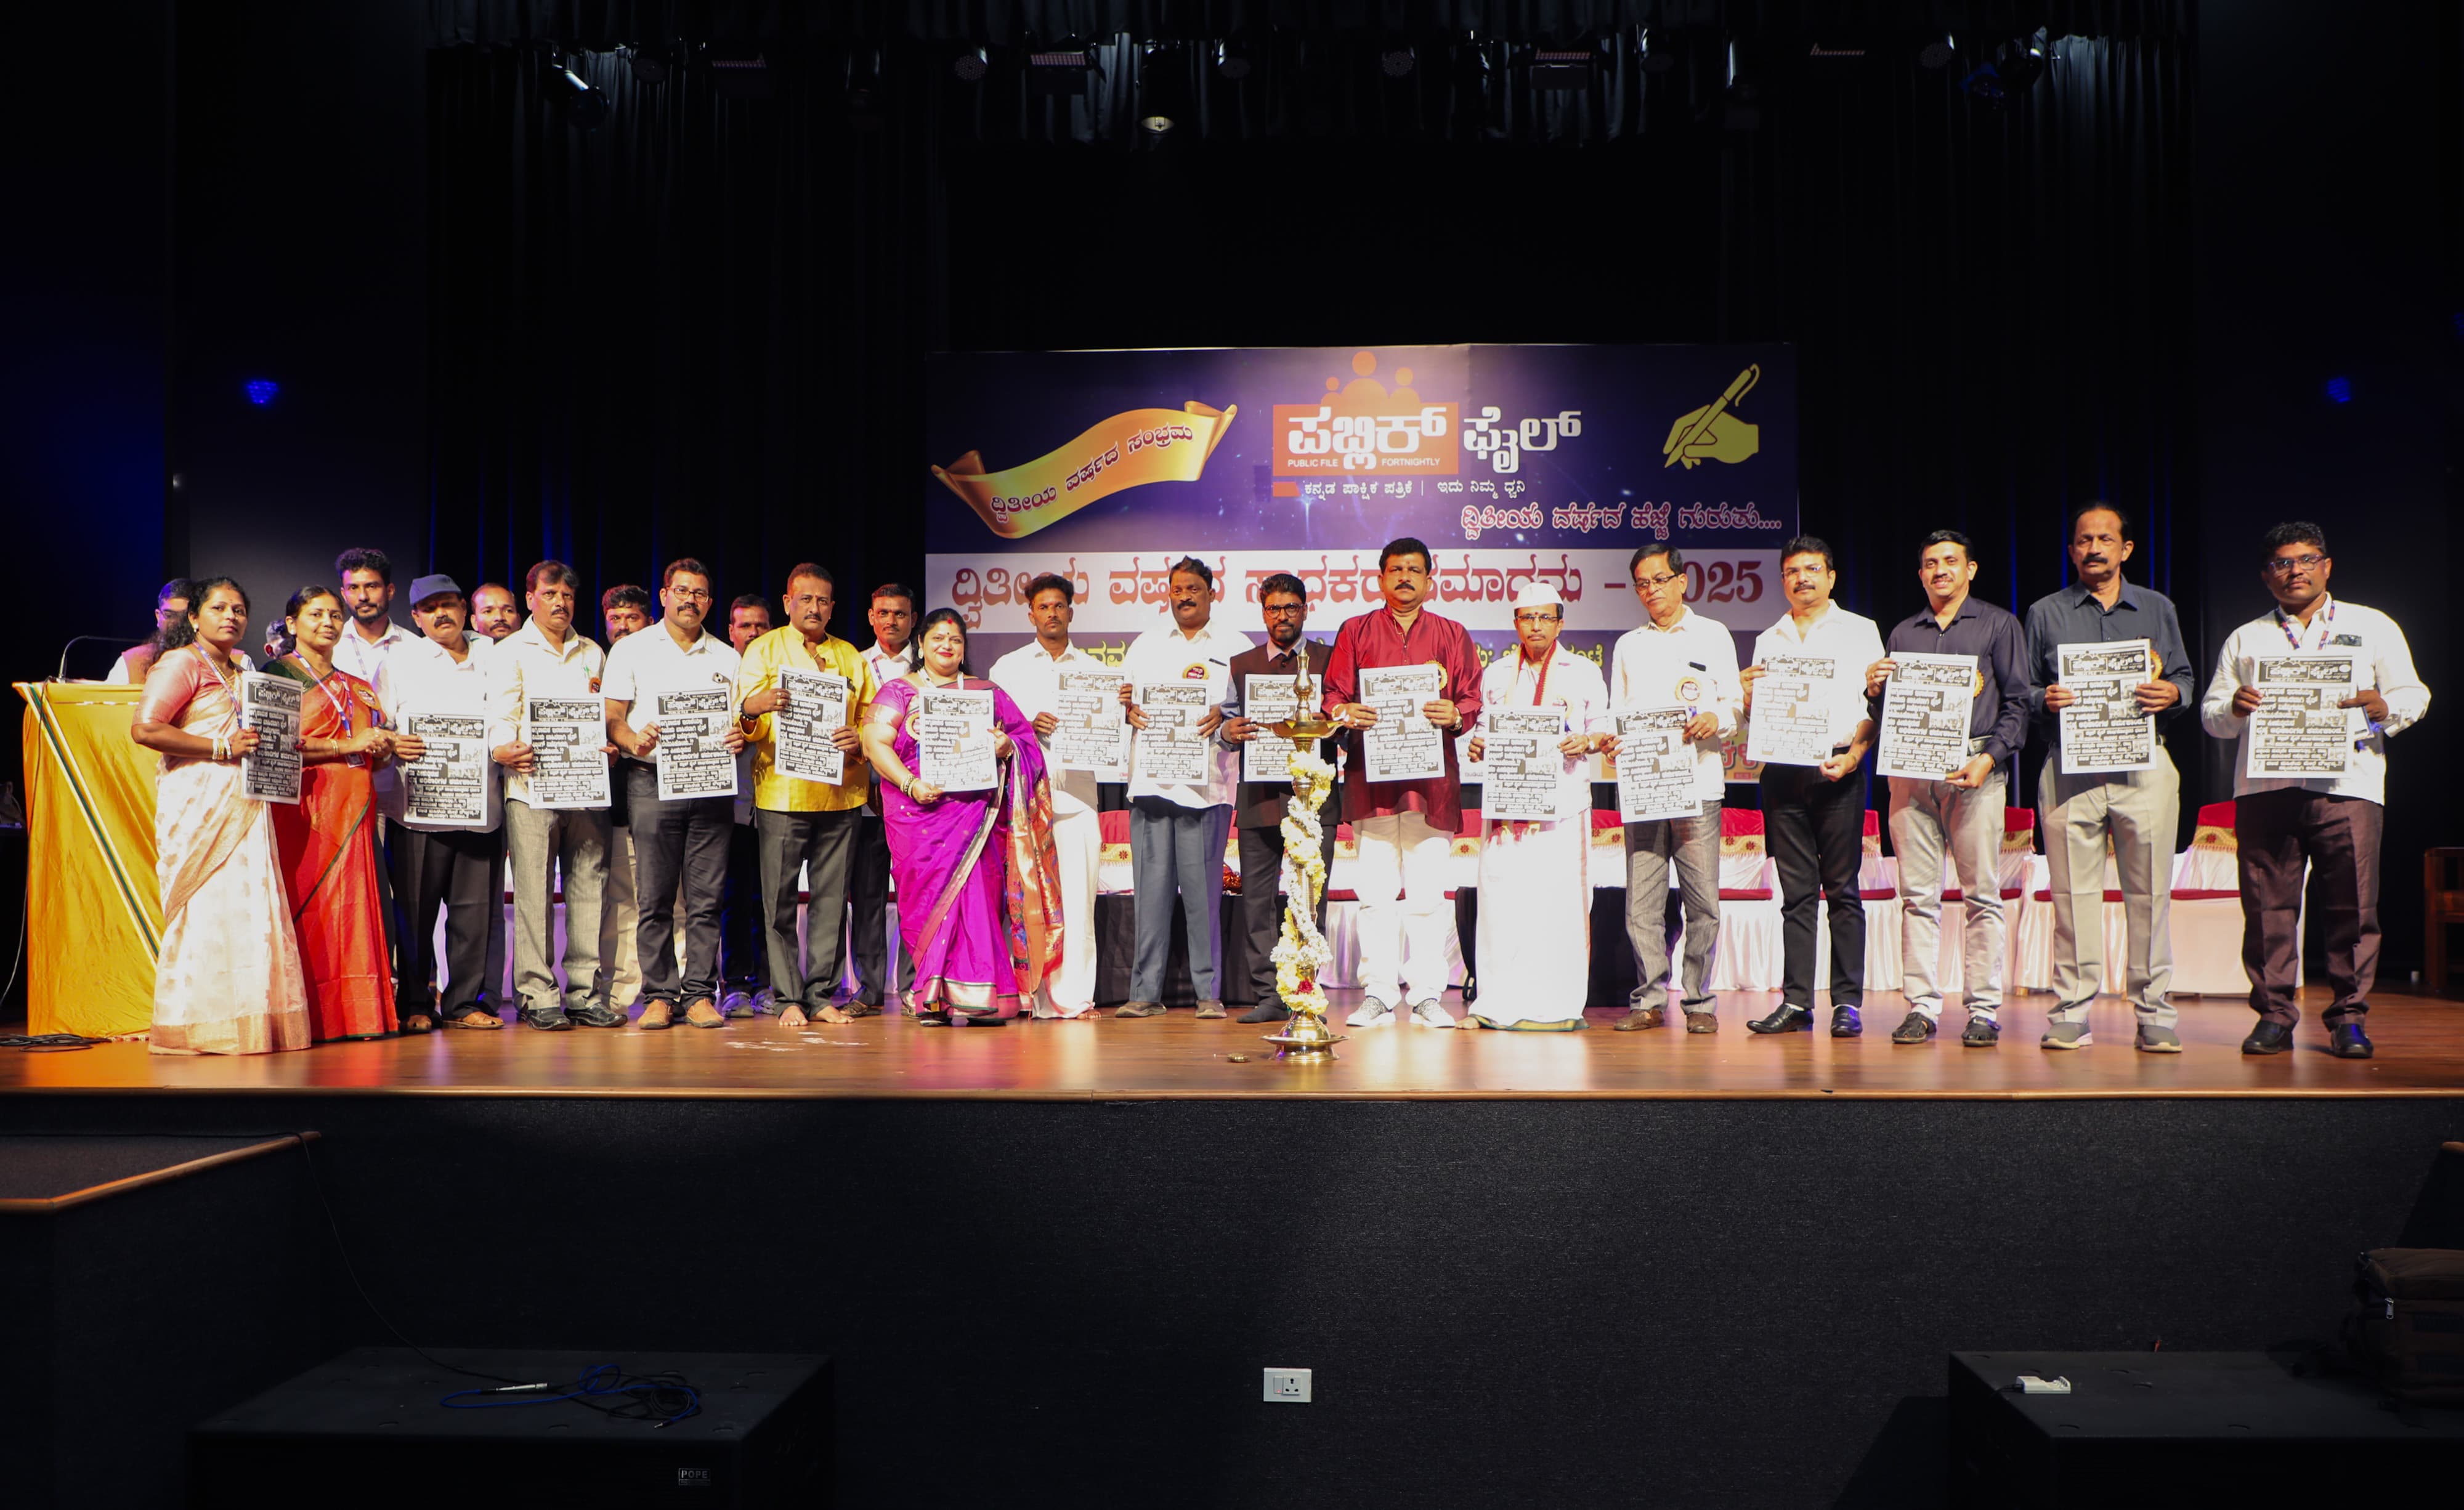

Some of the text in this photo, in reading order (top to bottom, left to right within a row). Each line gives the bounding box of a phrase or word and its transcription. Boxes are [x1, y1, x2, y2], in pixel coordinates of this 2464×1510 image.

[1288, 406, 1582, 474] ಪಬ್ಲಿಕ್ ಫೈಲ್
[990, 422, 1193, 522] ದ್ವಿತೀಯ ವರ್ಷದ ಸಂಭ್ರಮ
[1287, 458, 1441, 467] PUBLIC FILE FORTNIGHTLY
[1304, 480, 1412, 501] ಕನ್ನಡ ಪಾಕ್ಷಿಕ ಪತ್ರಿಕೆ
[1437, 480, 1464, 493] ಇದು
[1470, 480, 1499, 499] ನಿಮ್ಮ
[1461, 501, 1544, 540] ದ್ವಿತೀಯ
[1552, 501, 1627, 533] ವರ್ಷದ
[1631, 501, 1671, 540] ಹೆಜ್ಜೆ
[1682, 560, 1764, 604] 025
[681, 1470, 708, 1479] POPE
